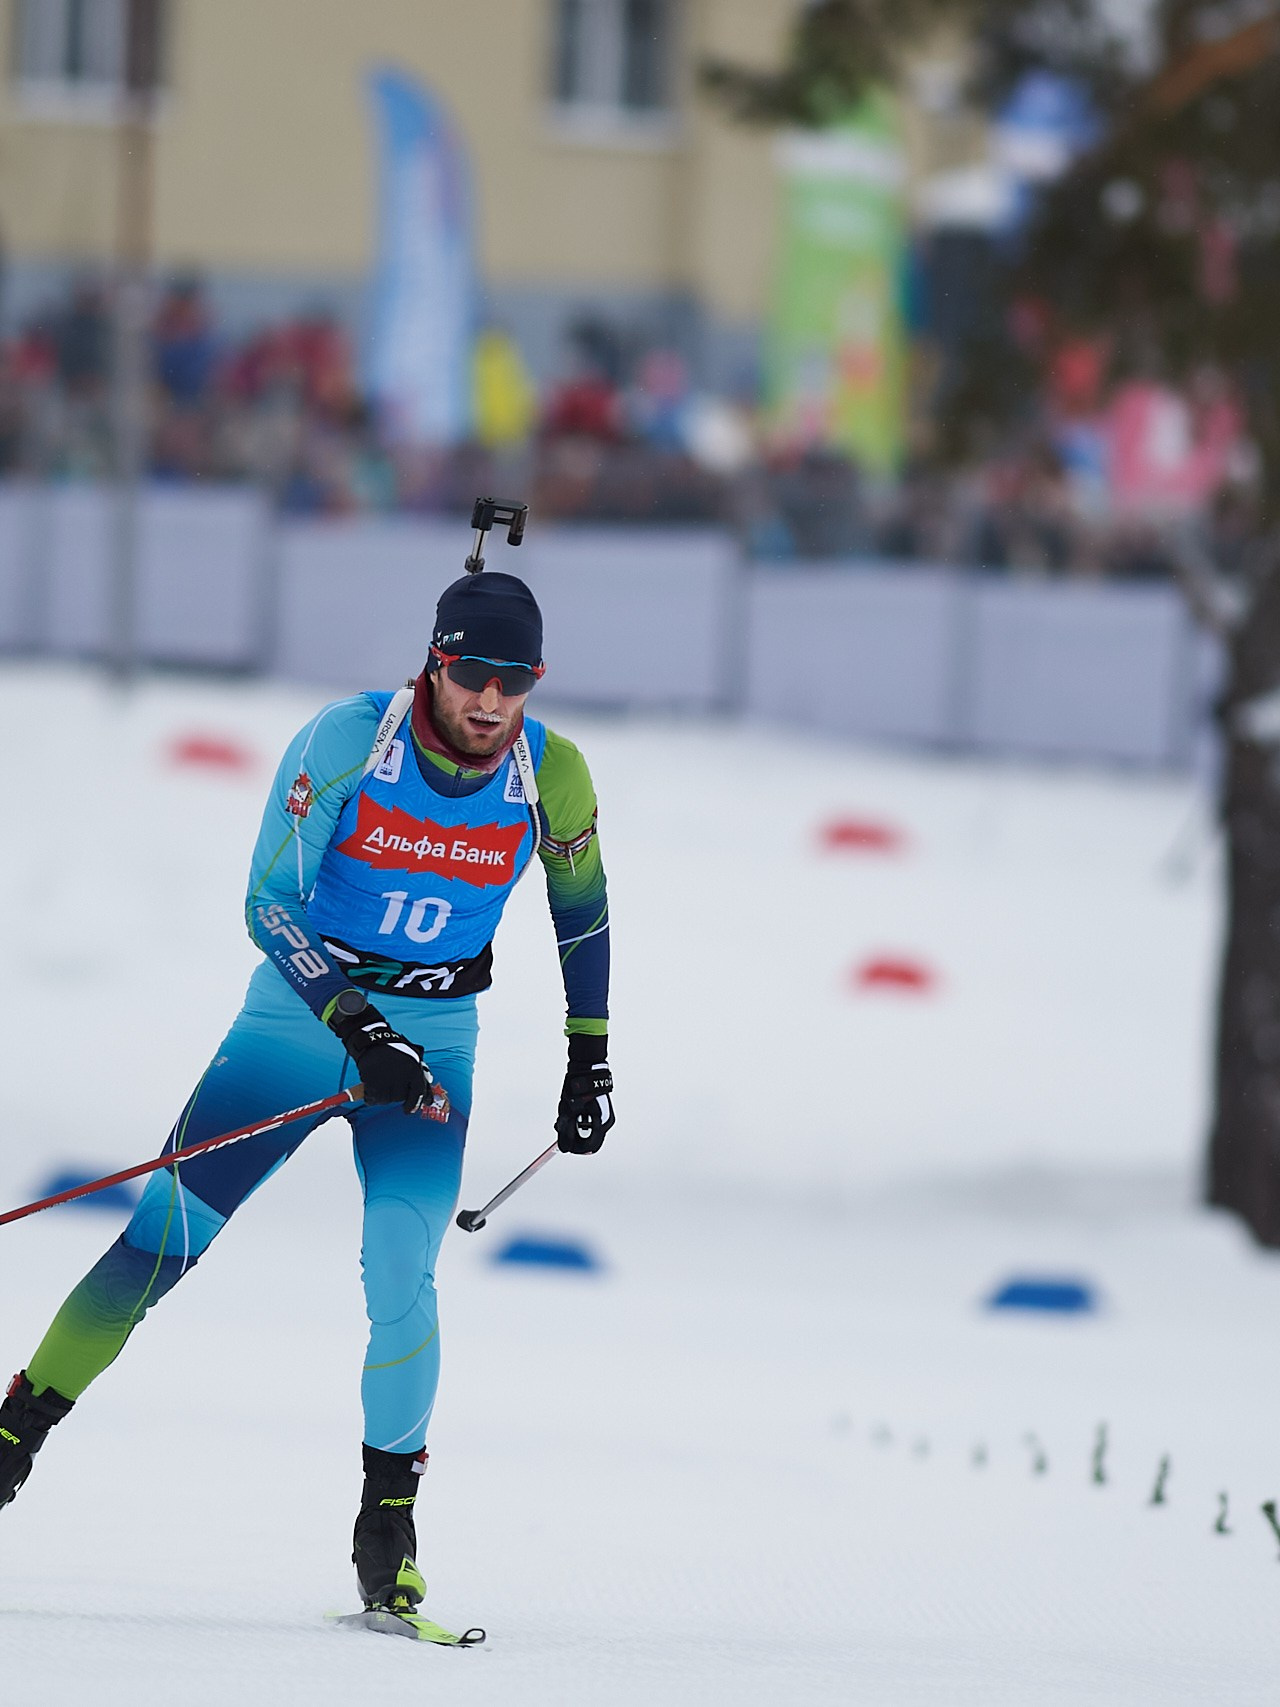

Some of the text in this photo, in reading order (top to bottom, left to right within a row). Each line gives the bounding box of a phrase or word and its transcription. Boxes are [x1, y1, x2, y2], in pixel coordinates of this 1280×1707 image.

[376, 713, 397, 745] LARSEN
[364, 826, 507, 866] Альфа Банк
[378, 890, 453, 943] 10
[256, 904, 330, 979] SPB
[274, 950, 309, 988] BIATHLON
